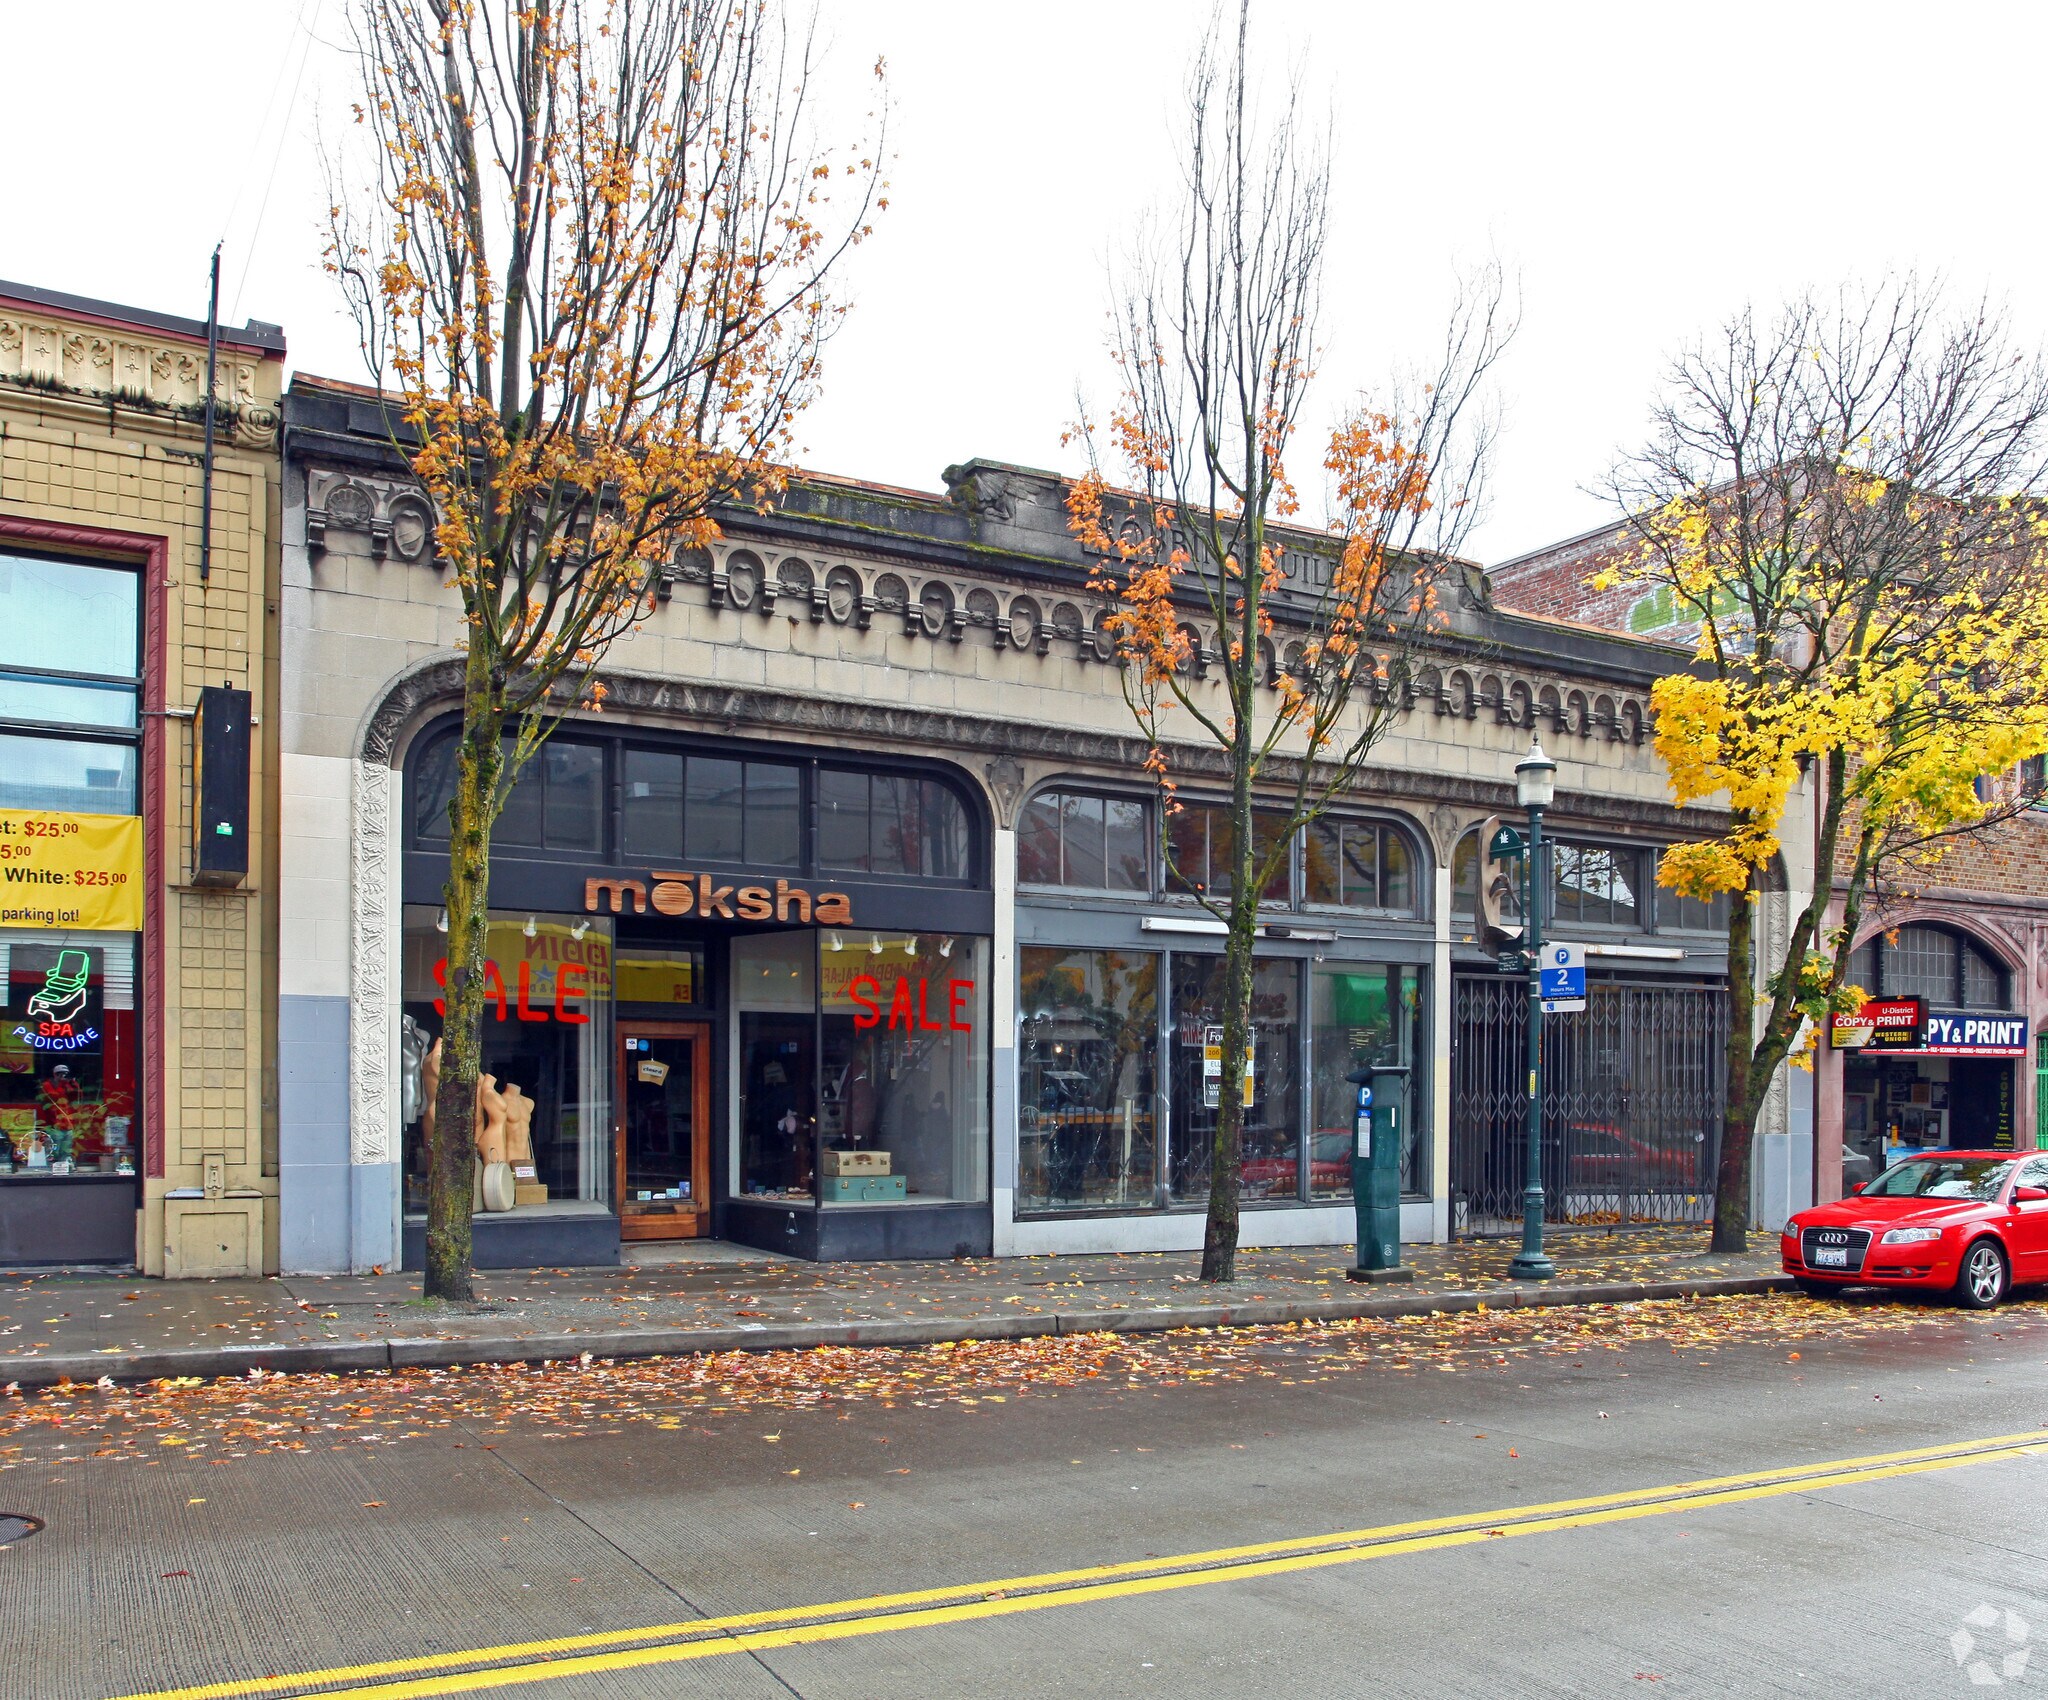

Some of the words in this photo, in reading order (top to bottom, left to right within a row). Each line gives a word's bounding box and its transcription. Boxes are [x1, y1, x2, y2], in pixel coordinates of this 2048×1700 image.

[0, 820, 17, 835] t:
[24, 820, 79, 838] $25.00
[0, 844, 31, 860] 5.00
[4, 867, 71, 885] White:
[73, 869, 127, 887] $25.00
[2, 907, 54, 925] parking
[57, 908, 79, 922] lot!
[1559, 951, 1567, 963] P
[1557, 969, 1568, 985] 2
[847, 974, 975, 1032] SALE
[1882, 1006, 1914, 1014] U-District
[39, 1022, 73, 1036] SPA
[1835, 1016, 1868, 1027] COPY
[1876, 1015, 1914, 1026] PRINT
[12, 1026, 99, 1050] PEDICURE
[1952, 1027, 1961, 1043] &
[1964, 1020, 2024, 1045] PRINT
[643, 1066, 663, 1075] closed
[1362, 1087, 1371, 1105] P
